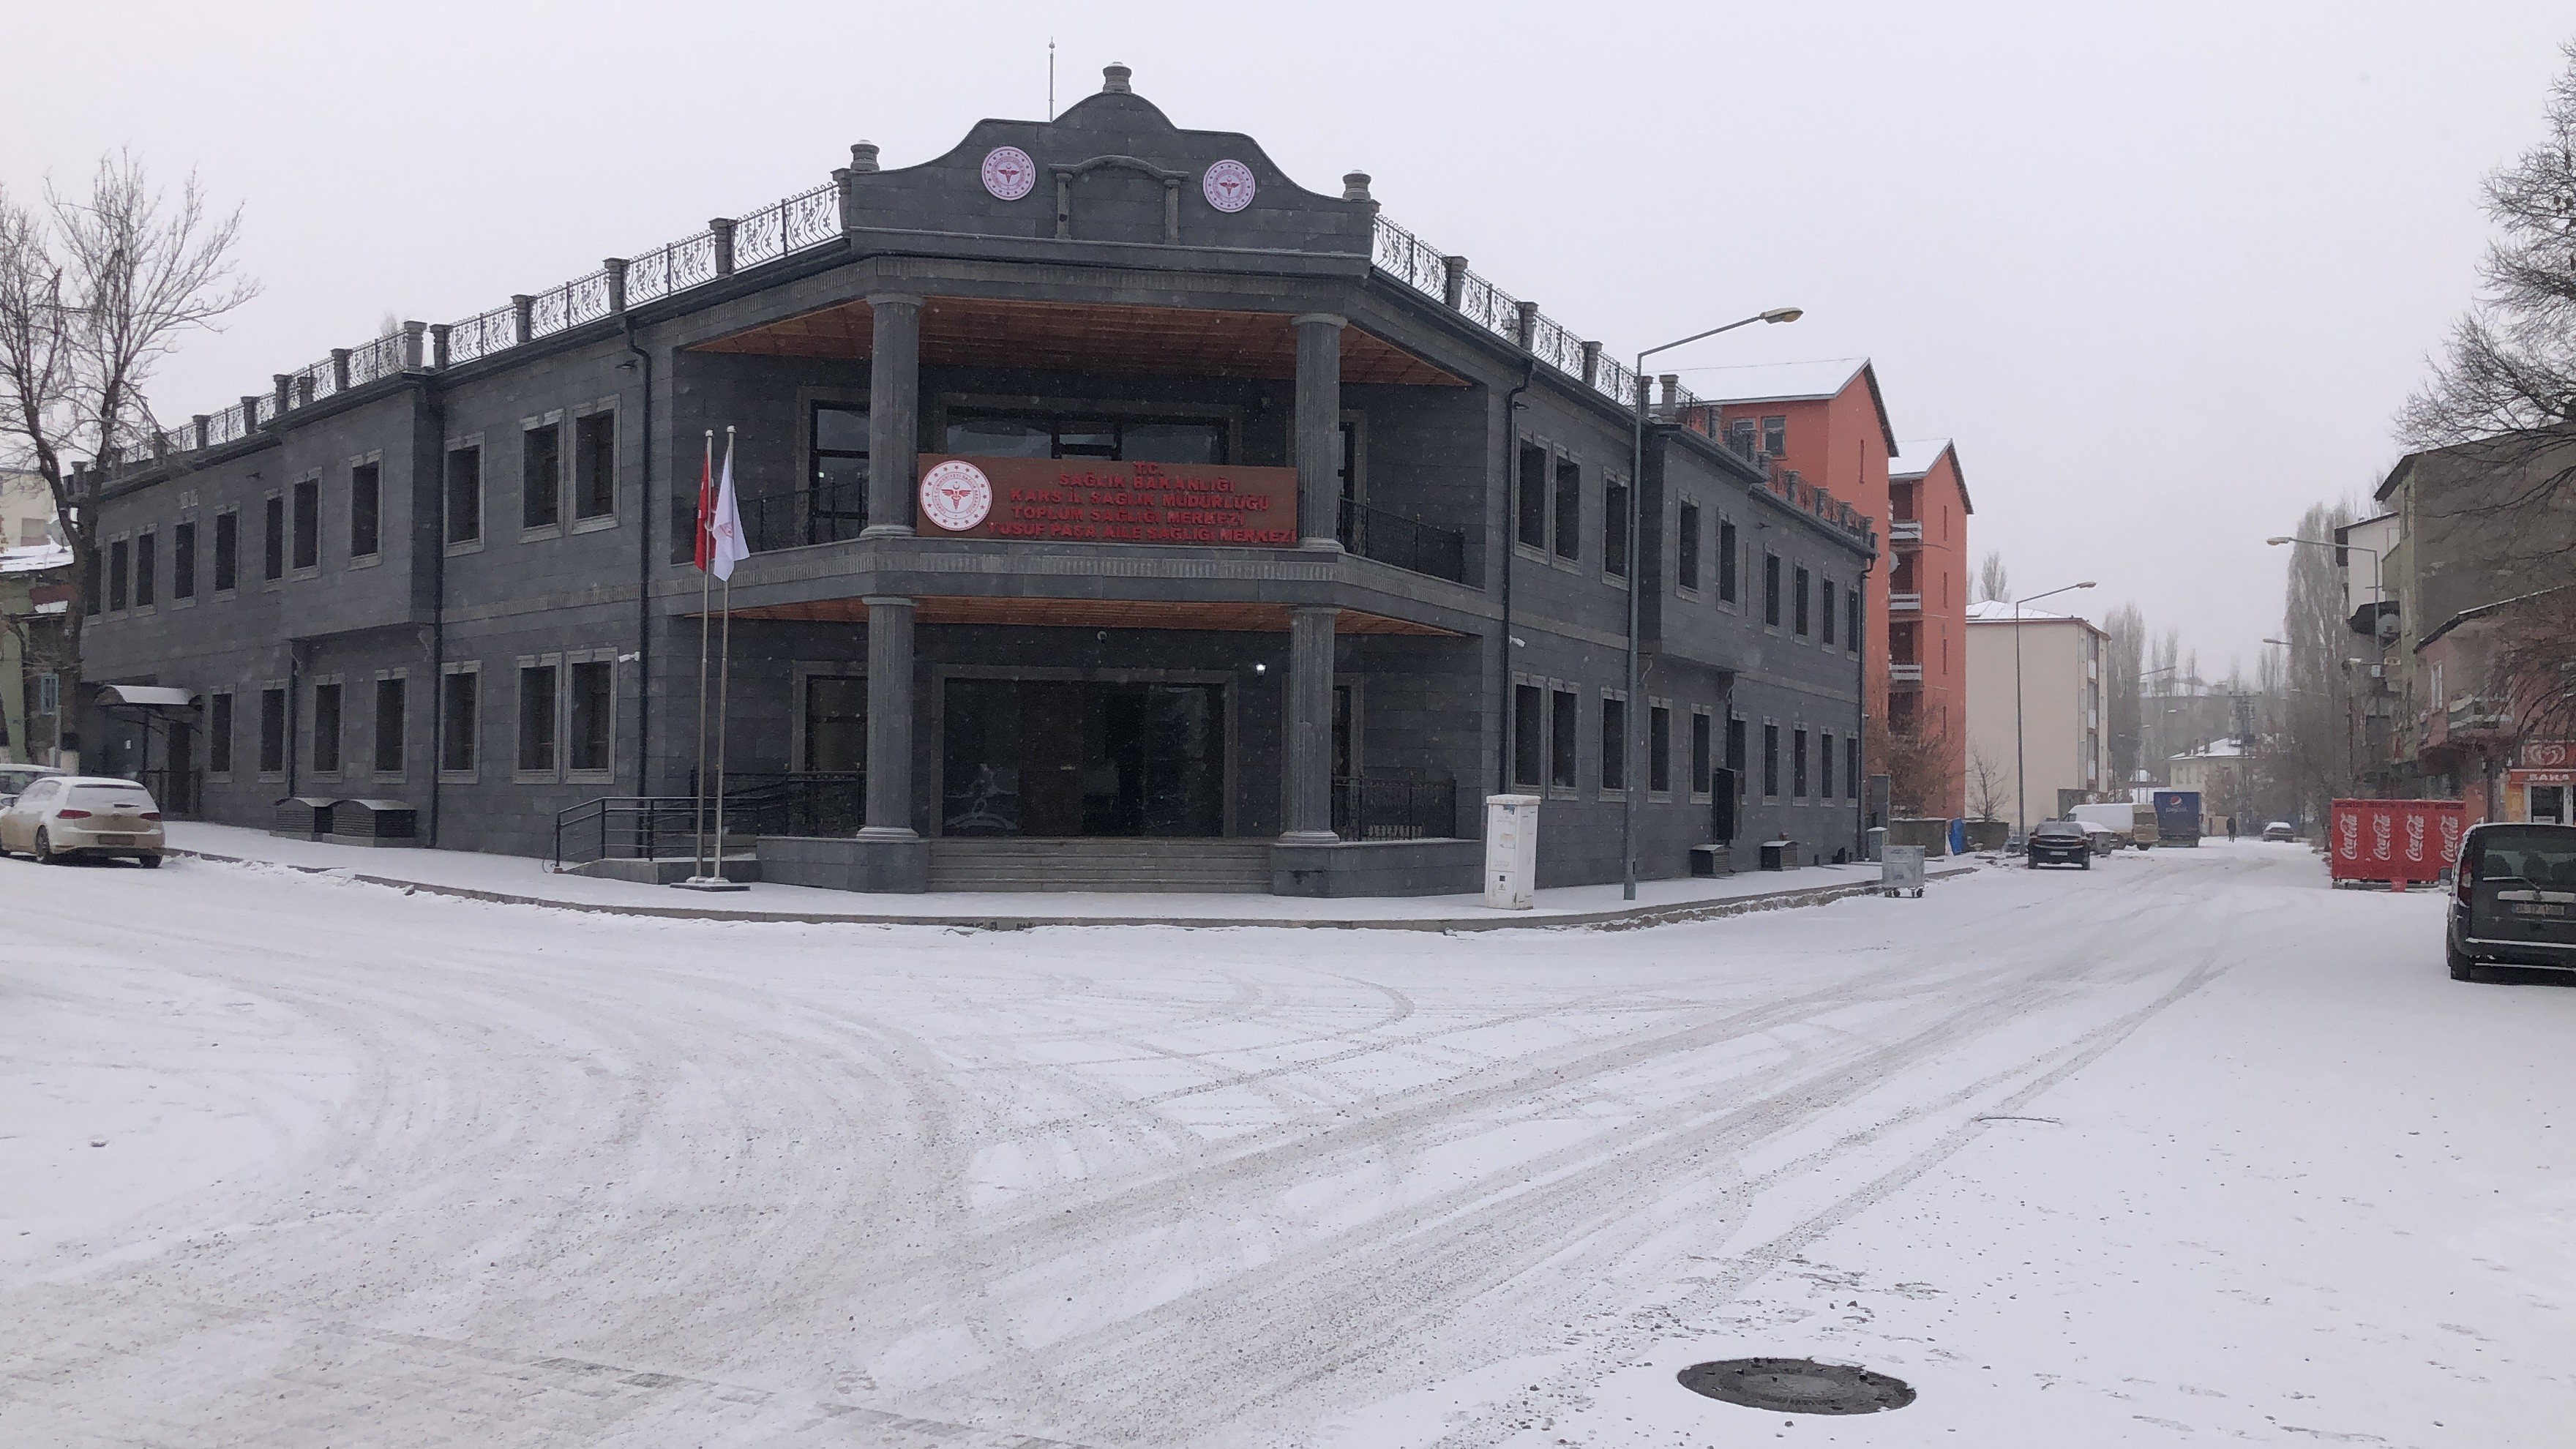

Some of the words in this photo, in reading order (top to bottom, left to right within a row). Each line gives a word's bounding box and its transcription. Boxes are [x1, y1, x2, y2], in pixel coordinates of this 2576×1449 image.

[1059, 472, 1125, 488] SAĞLIK
[1133, 476, 1235, 493] BAKANLIĞI
[1009, 488, 1061, 503] KARS
[1068, 488, 1083, 503] İL
[1090, 491, 1155, 506] SAĞLIK
[1162, 494, 1271, 511] MÜDÜRLÜĞÜ
[1011, 506, 1083, 521] TOPLUM
[1090, 507, 1161, 523] SAĞLIĞI
[1167, 511, 1245, 525] MERKEZİ
[987, 522, 1045, 536] YUSUF
[1049, 523, 1096, 540] PAŞA
[1102, 523, 1142, 539] AİLE
[1146, 525, 1215, 542] SAĞLIĞI
[1219, 528, 1297, 543] MERKEZİ
